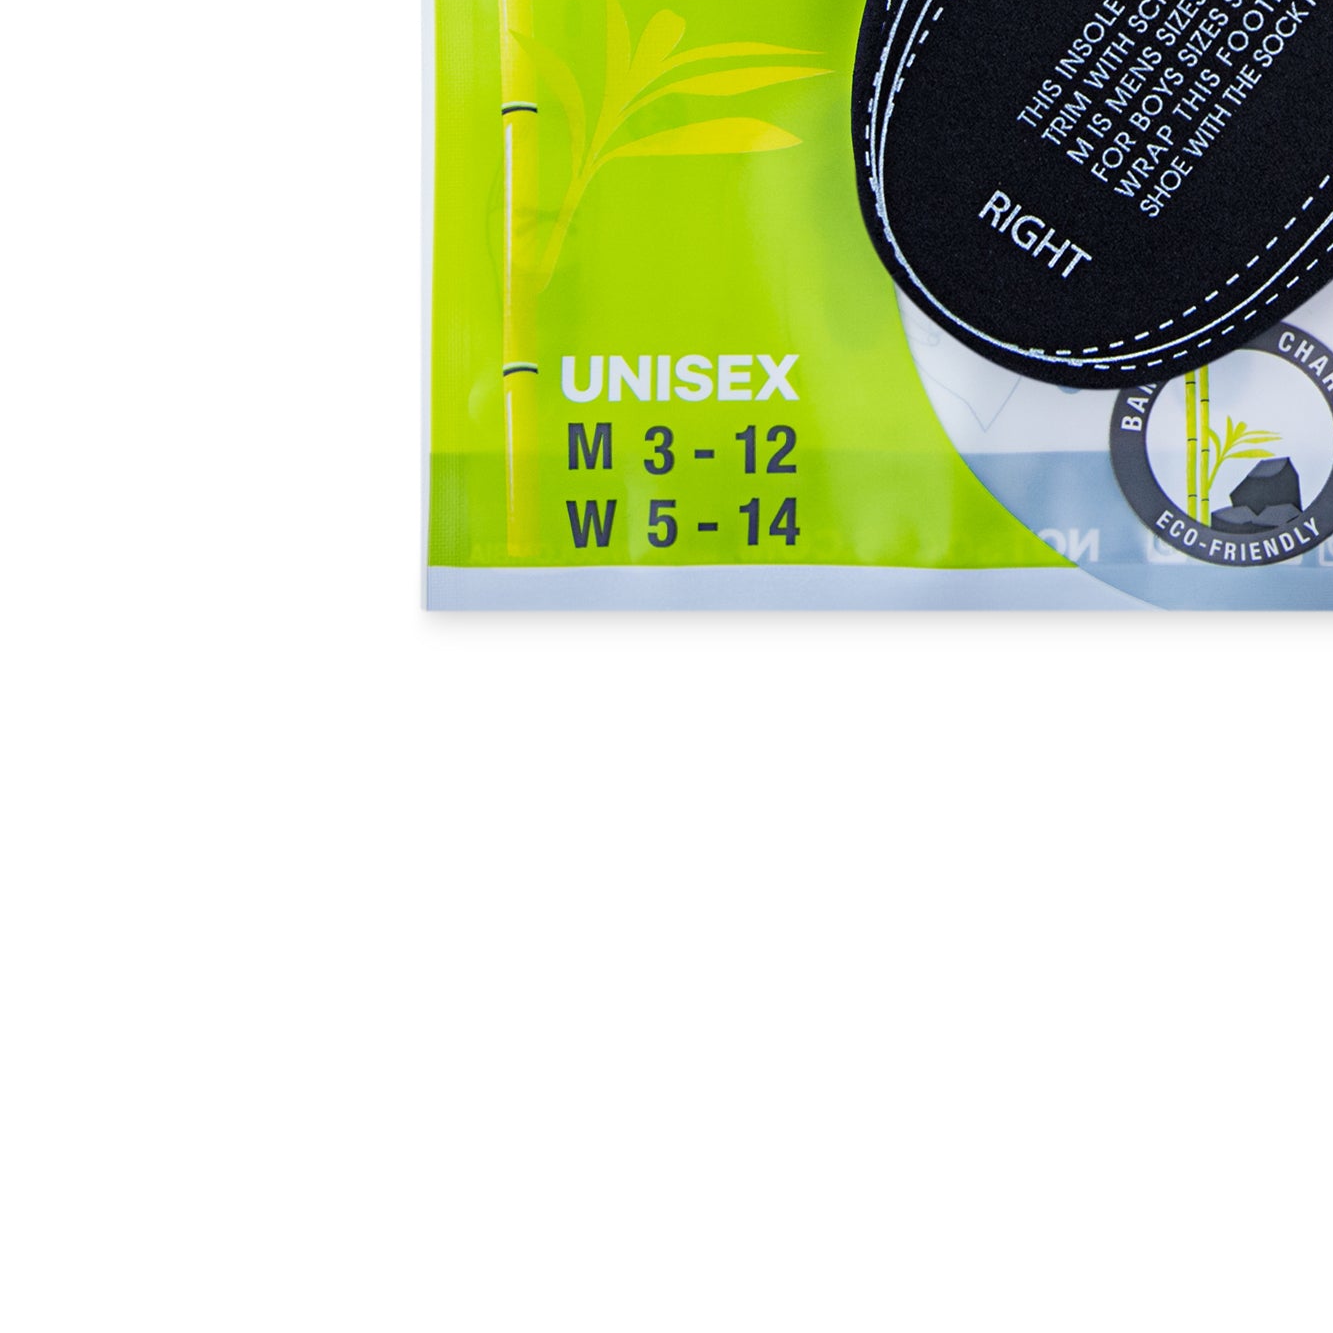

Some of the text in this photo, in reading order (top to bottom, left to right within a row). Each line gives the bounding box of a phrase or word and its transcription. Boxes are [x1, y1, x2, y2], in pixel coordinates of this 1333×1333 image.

[1016, 79, 1063, 127] THIS
[1040, 90, 1092, 145] TRIM
[1082, 32, 1136, 89] WITH
[1066, 136, 1095, 165] M
[1086, 112, 1113, 138] IS
[1104, 46, 1162, 114] MENS
[1090, 131, 1137, 183] FOR
[1128, 67, 1184, 132] BOYS
[1177, 7, 1229, 68] SIZES
[1113, 124, 1174, 197] WRAP
[1172, 68, 1221, 121] THIS
[1139, 155, 1194, 217] SHOE
[1182, 103, 1232, 157] WITH
[1221, 63, 1263, 106] THE
[1252, 1, 1310, 68] SOCK
[976, 189, 1093, 282] RIGHT
[561, 353, 801, 405] UNISEX
[567, 421, 614, 471] M
[566, 498, 618, 549] W
[1155, 508, 1323, 563] ECO-FRIENDLY
